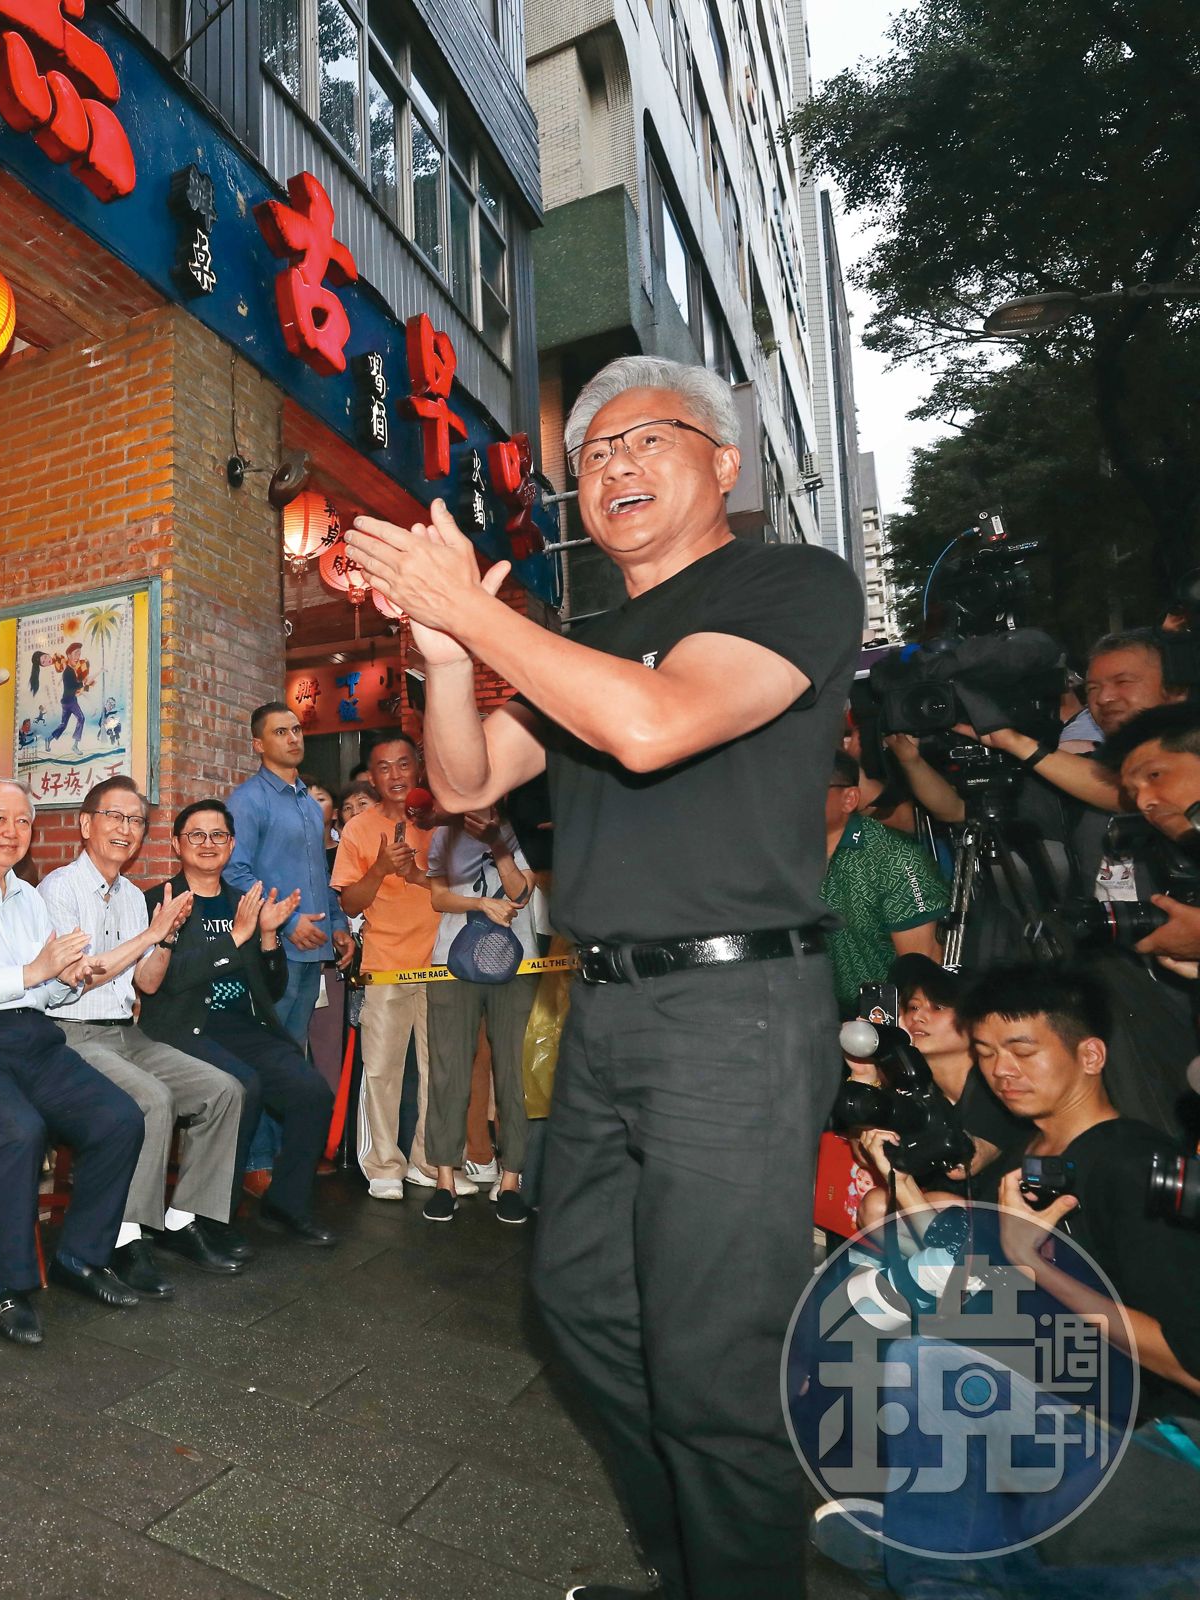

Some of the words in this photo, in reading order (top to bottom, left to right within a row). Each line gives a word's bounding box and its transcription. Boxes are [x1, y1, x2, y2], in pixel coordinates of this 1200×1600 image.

[904, 864, 926, 914] J.LINDEBERG
[529, 960, 548, 969] ALL
[548, 958, 567, 967] THE
[398, 972, 412, 981] ALL
[412, 971, 427, 979] THE
[428, 969, 449, 978] RAGE
